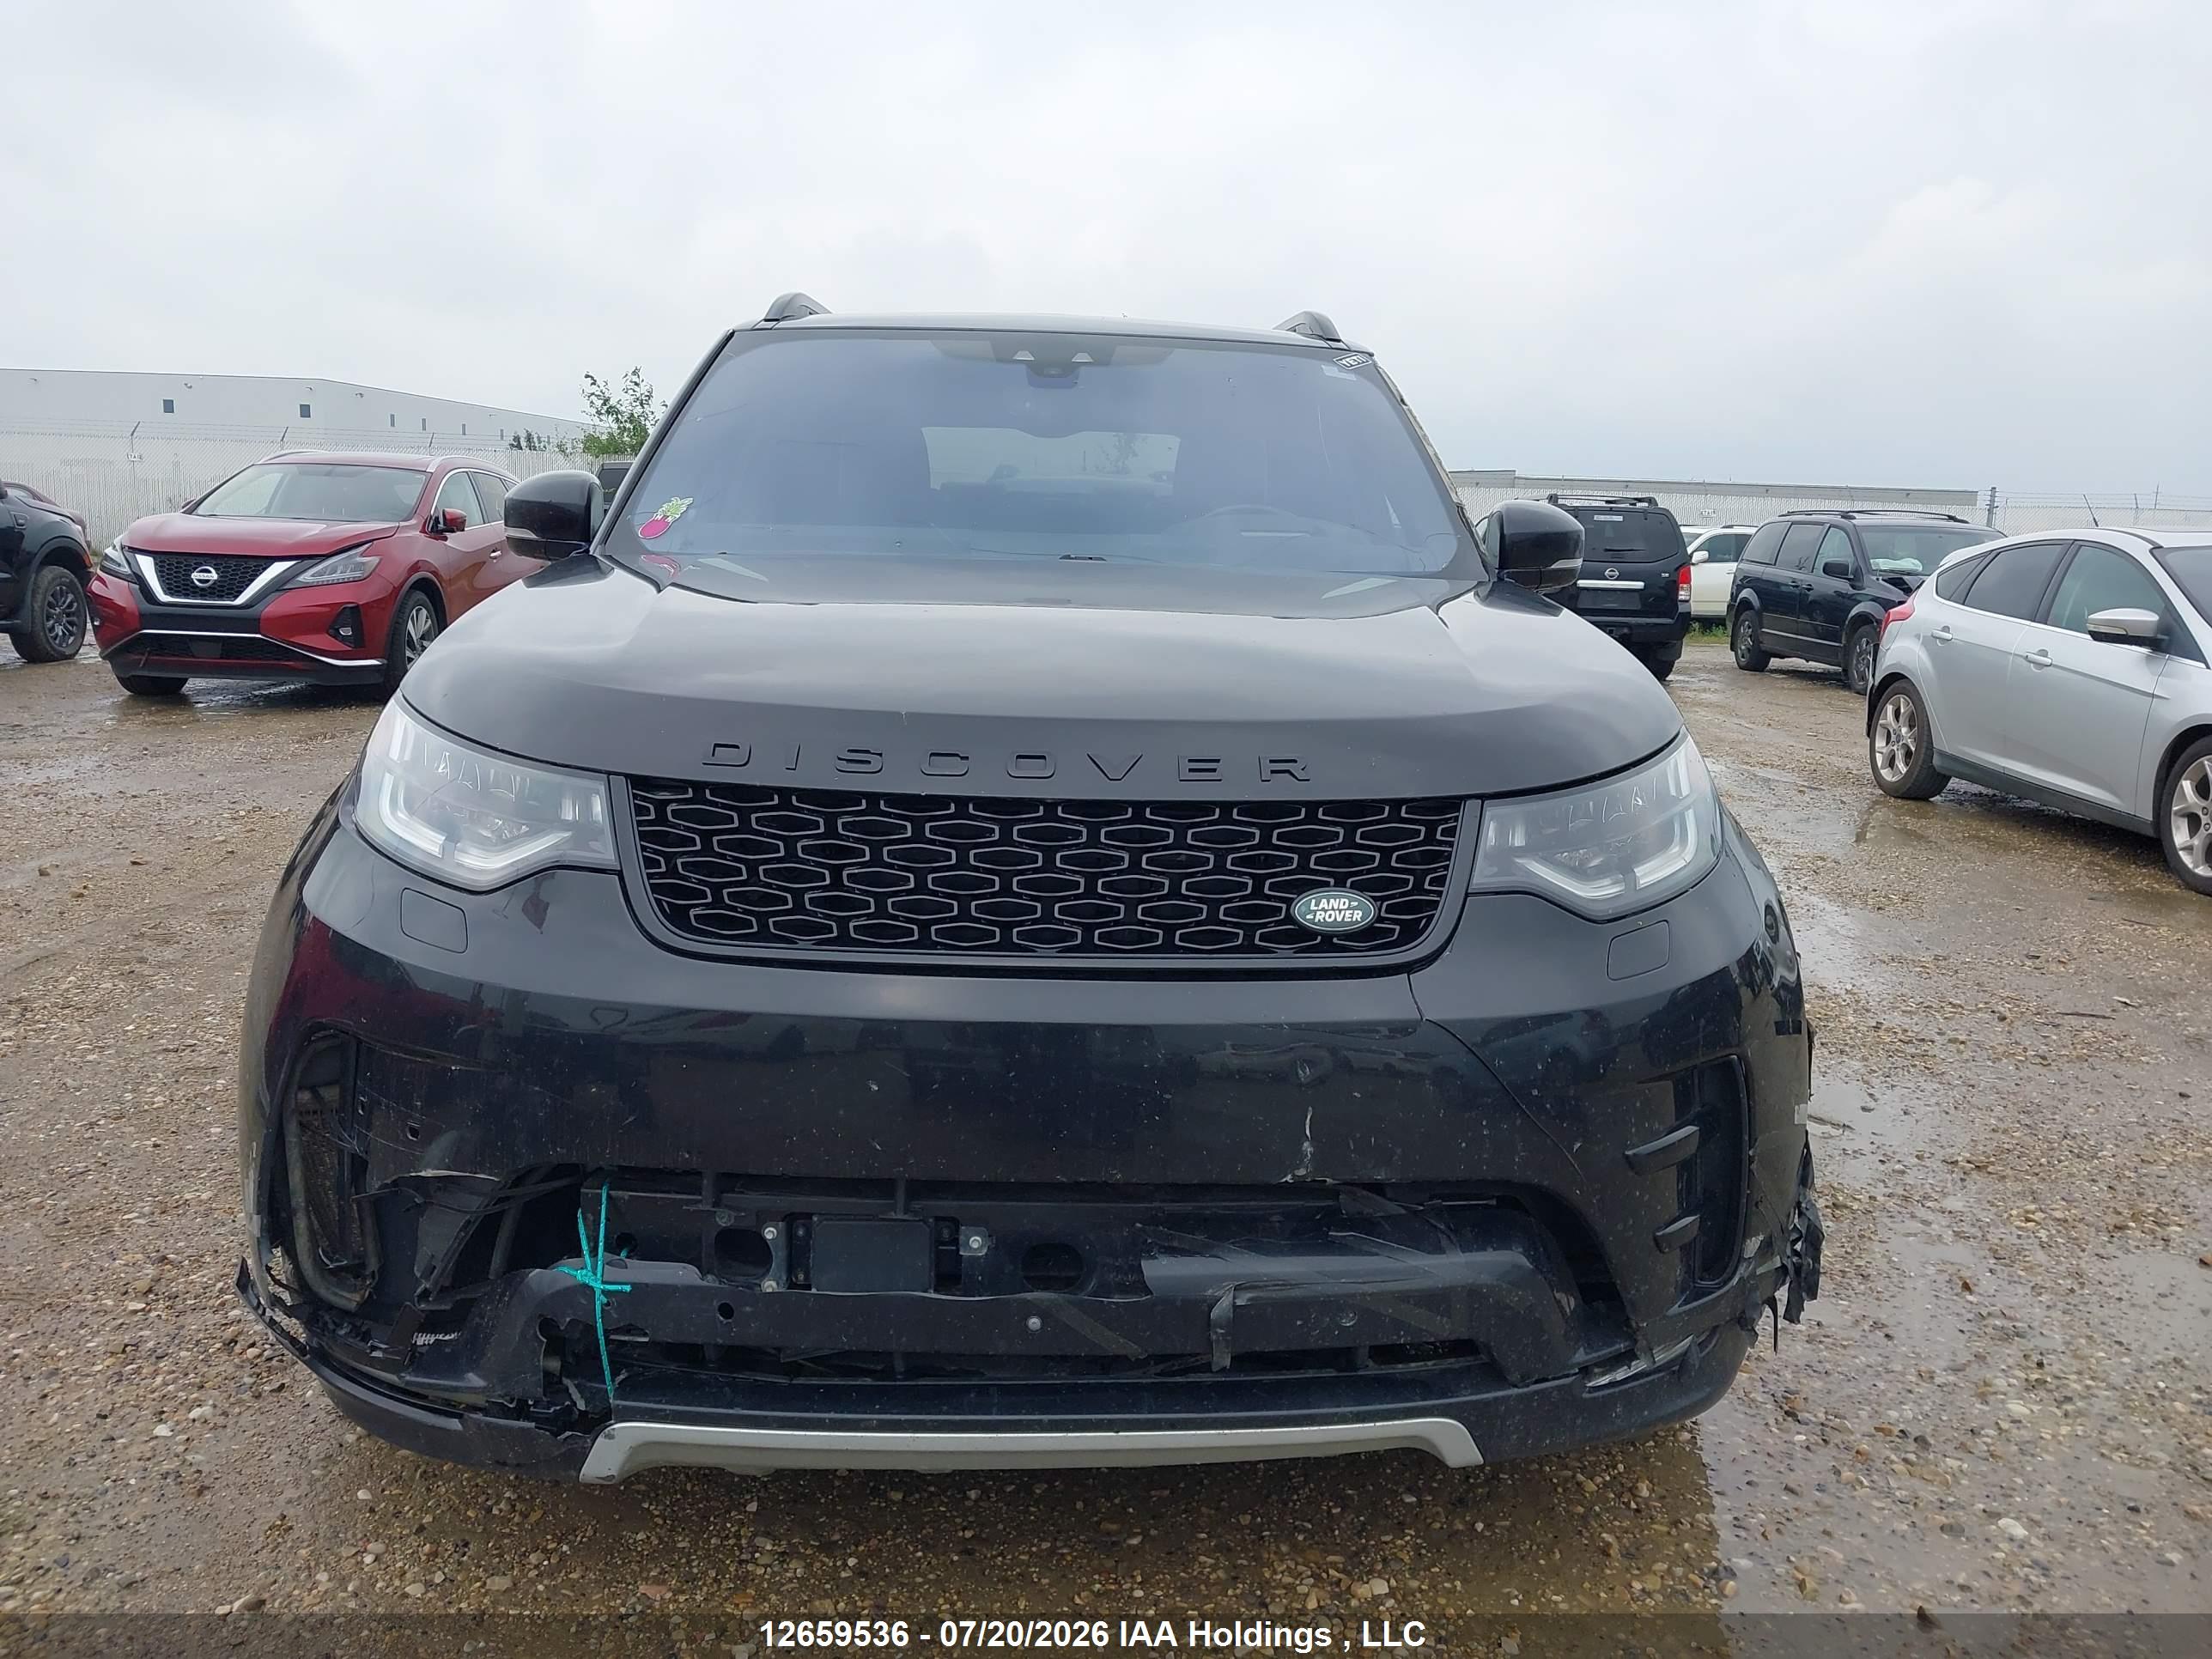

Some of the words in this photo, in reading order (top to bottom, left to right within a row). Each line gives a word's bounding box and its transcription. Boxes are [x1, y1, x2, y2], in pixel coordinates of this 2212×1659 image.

[1338, 355, 1367, 367] YETI
[701, 740, 1311, 782] DISCOVER
[1310, 898, 1349, 910] LAND
[1314, 910, 1363, 923] ROVER
